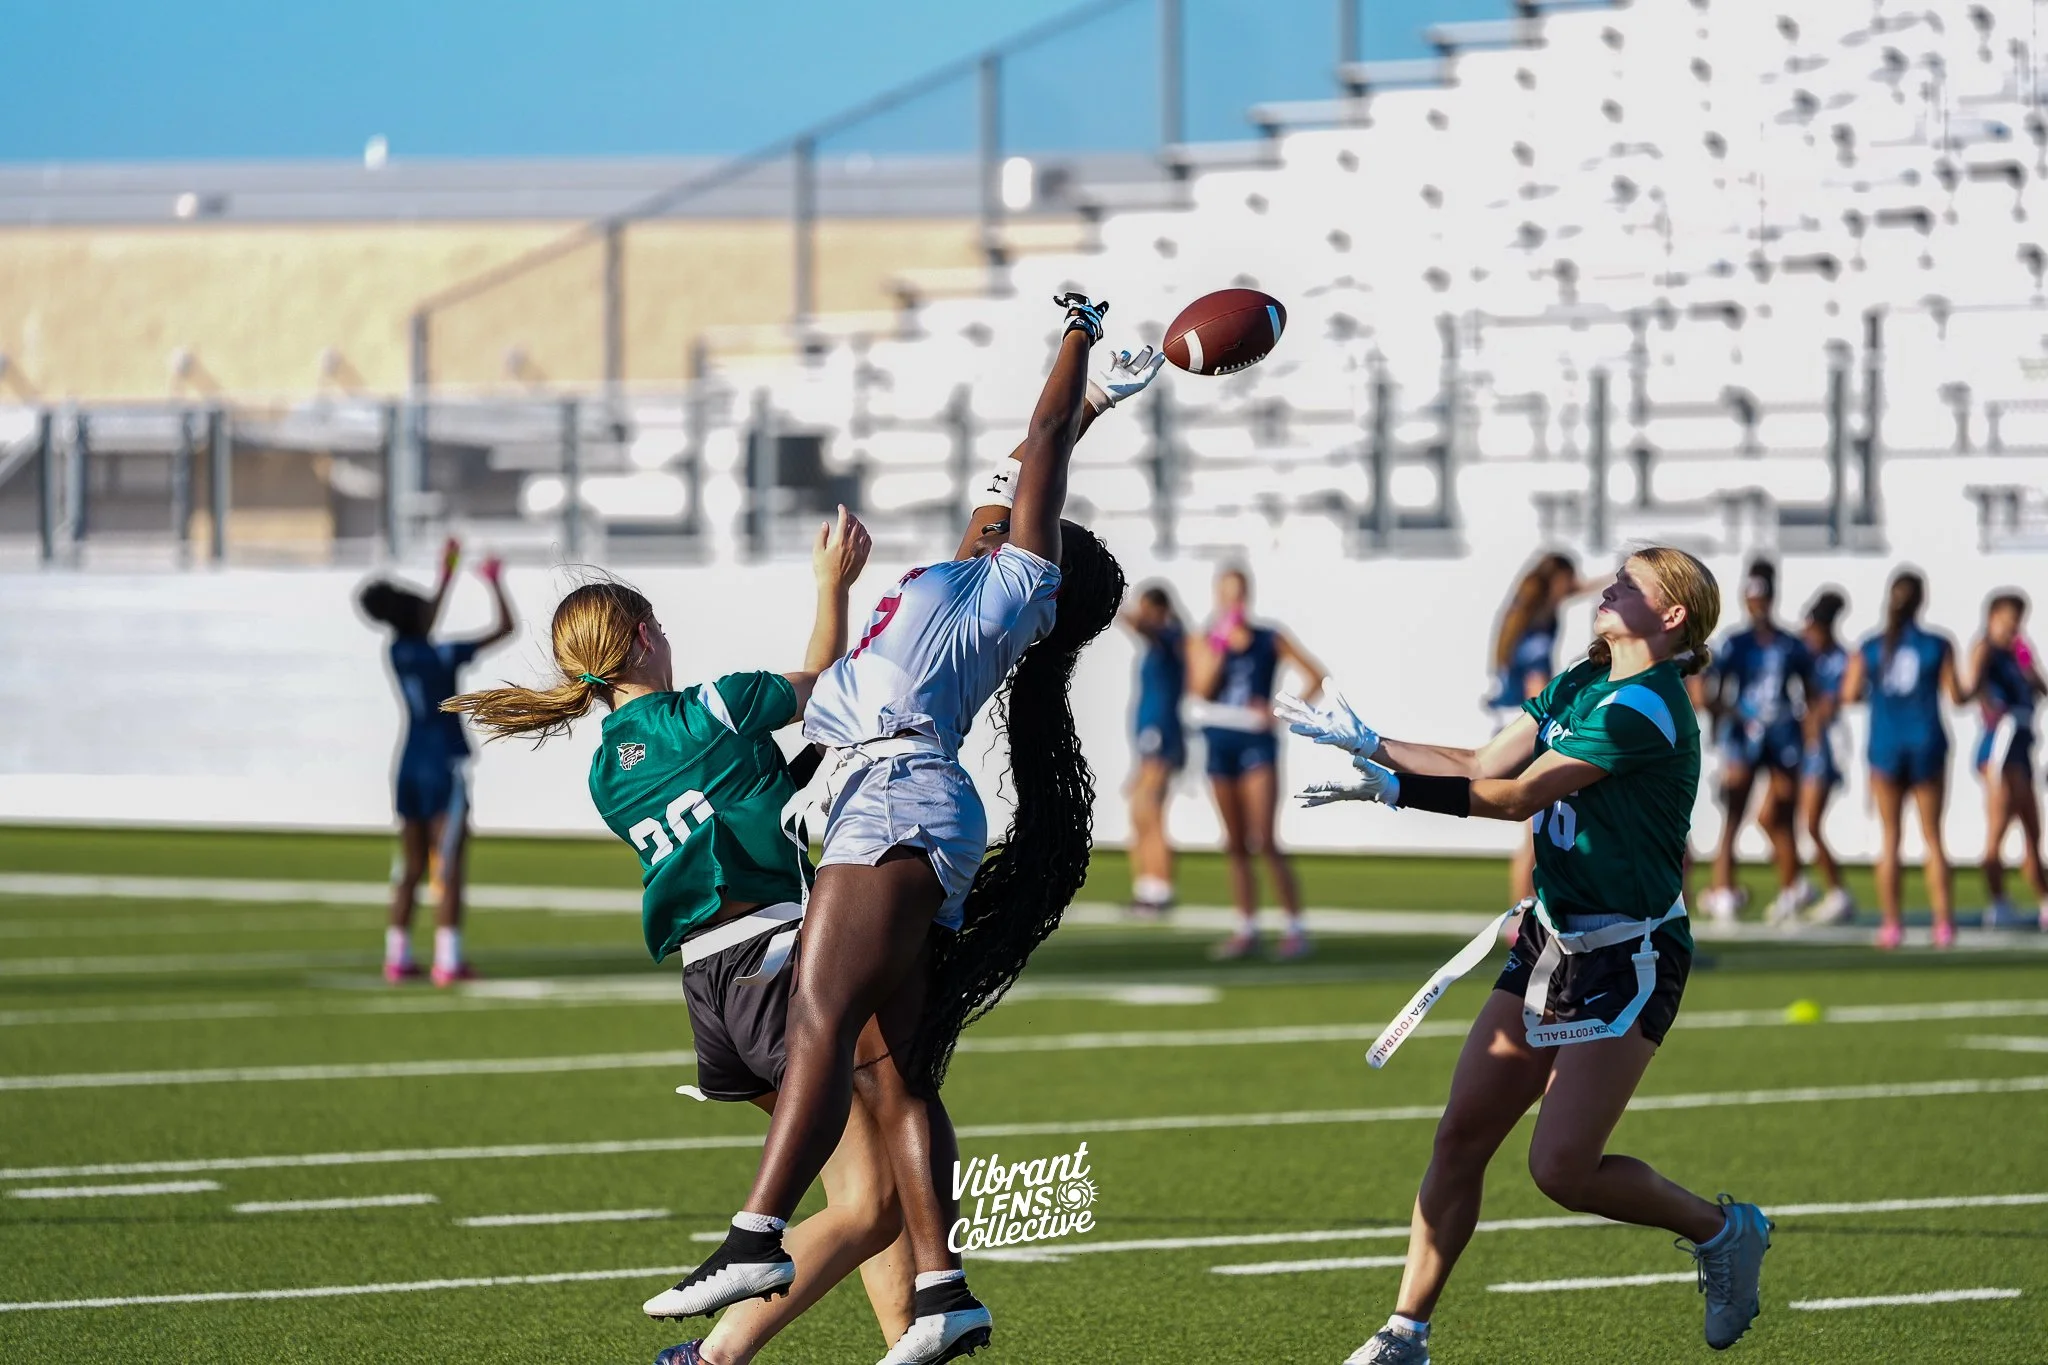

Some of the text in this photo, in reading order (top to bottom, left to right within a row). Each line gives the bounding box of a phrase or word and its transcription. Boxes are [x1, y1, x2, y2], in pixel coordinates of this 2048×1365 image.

[1373, 992, 1434, 1062] USA FOOTBALL
[1536, 1026, 1594, 1042] FOOTBALL
